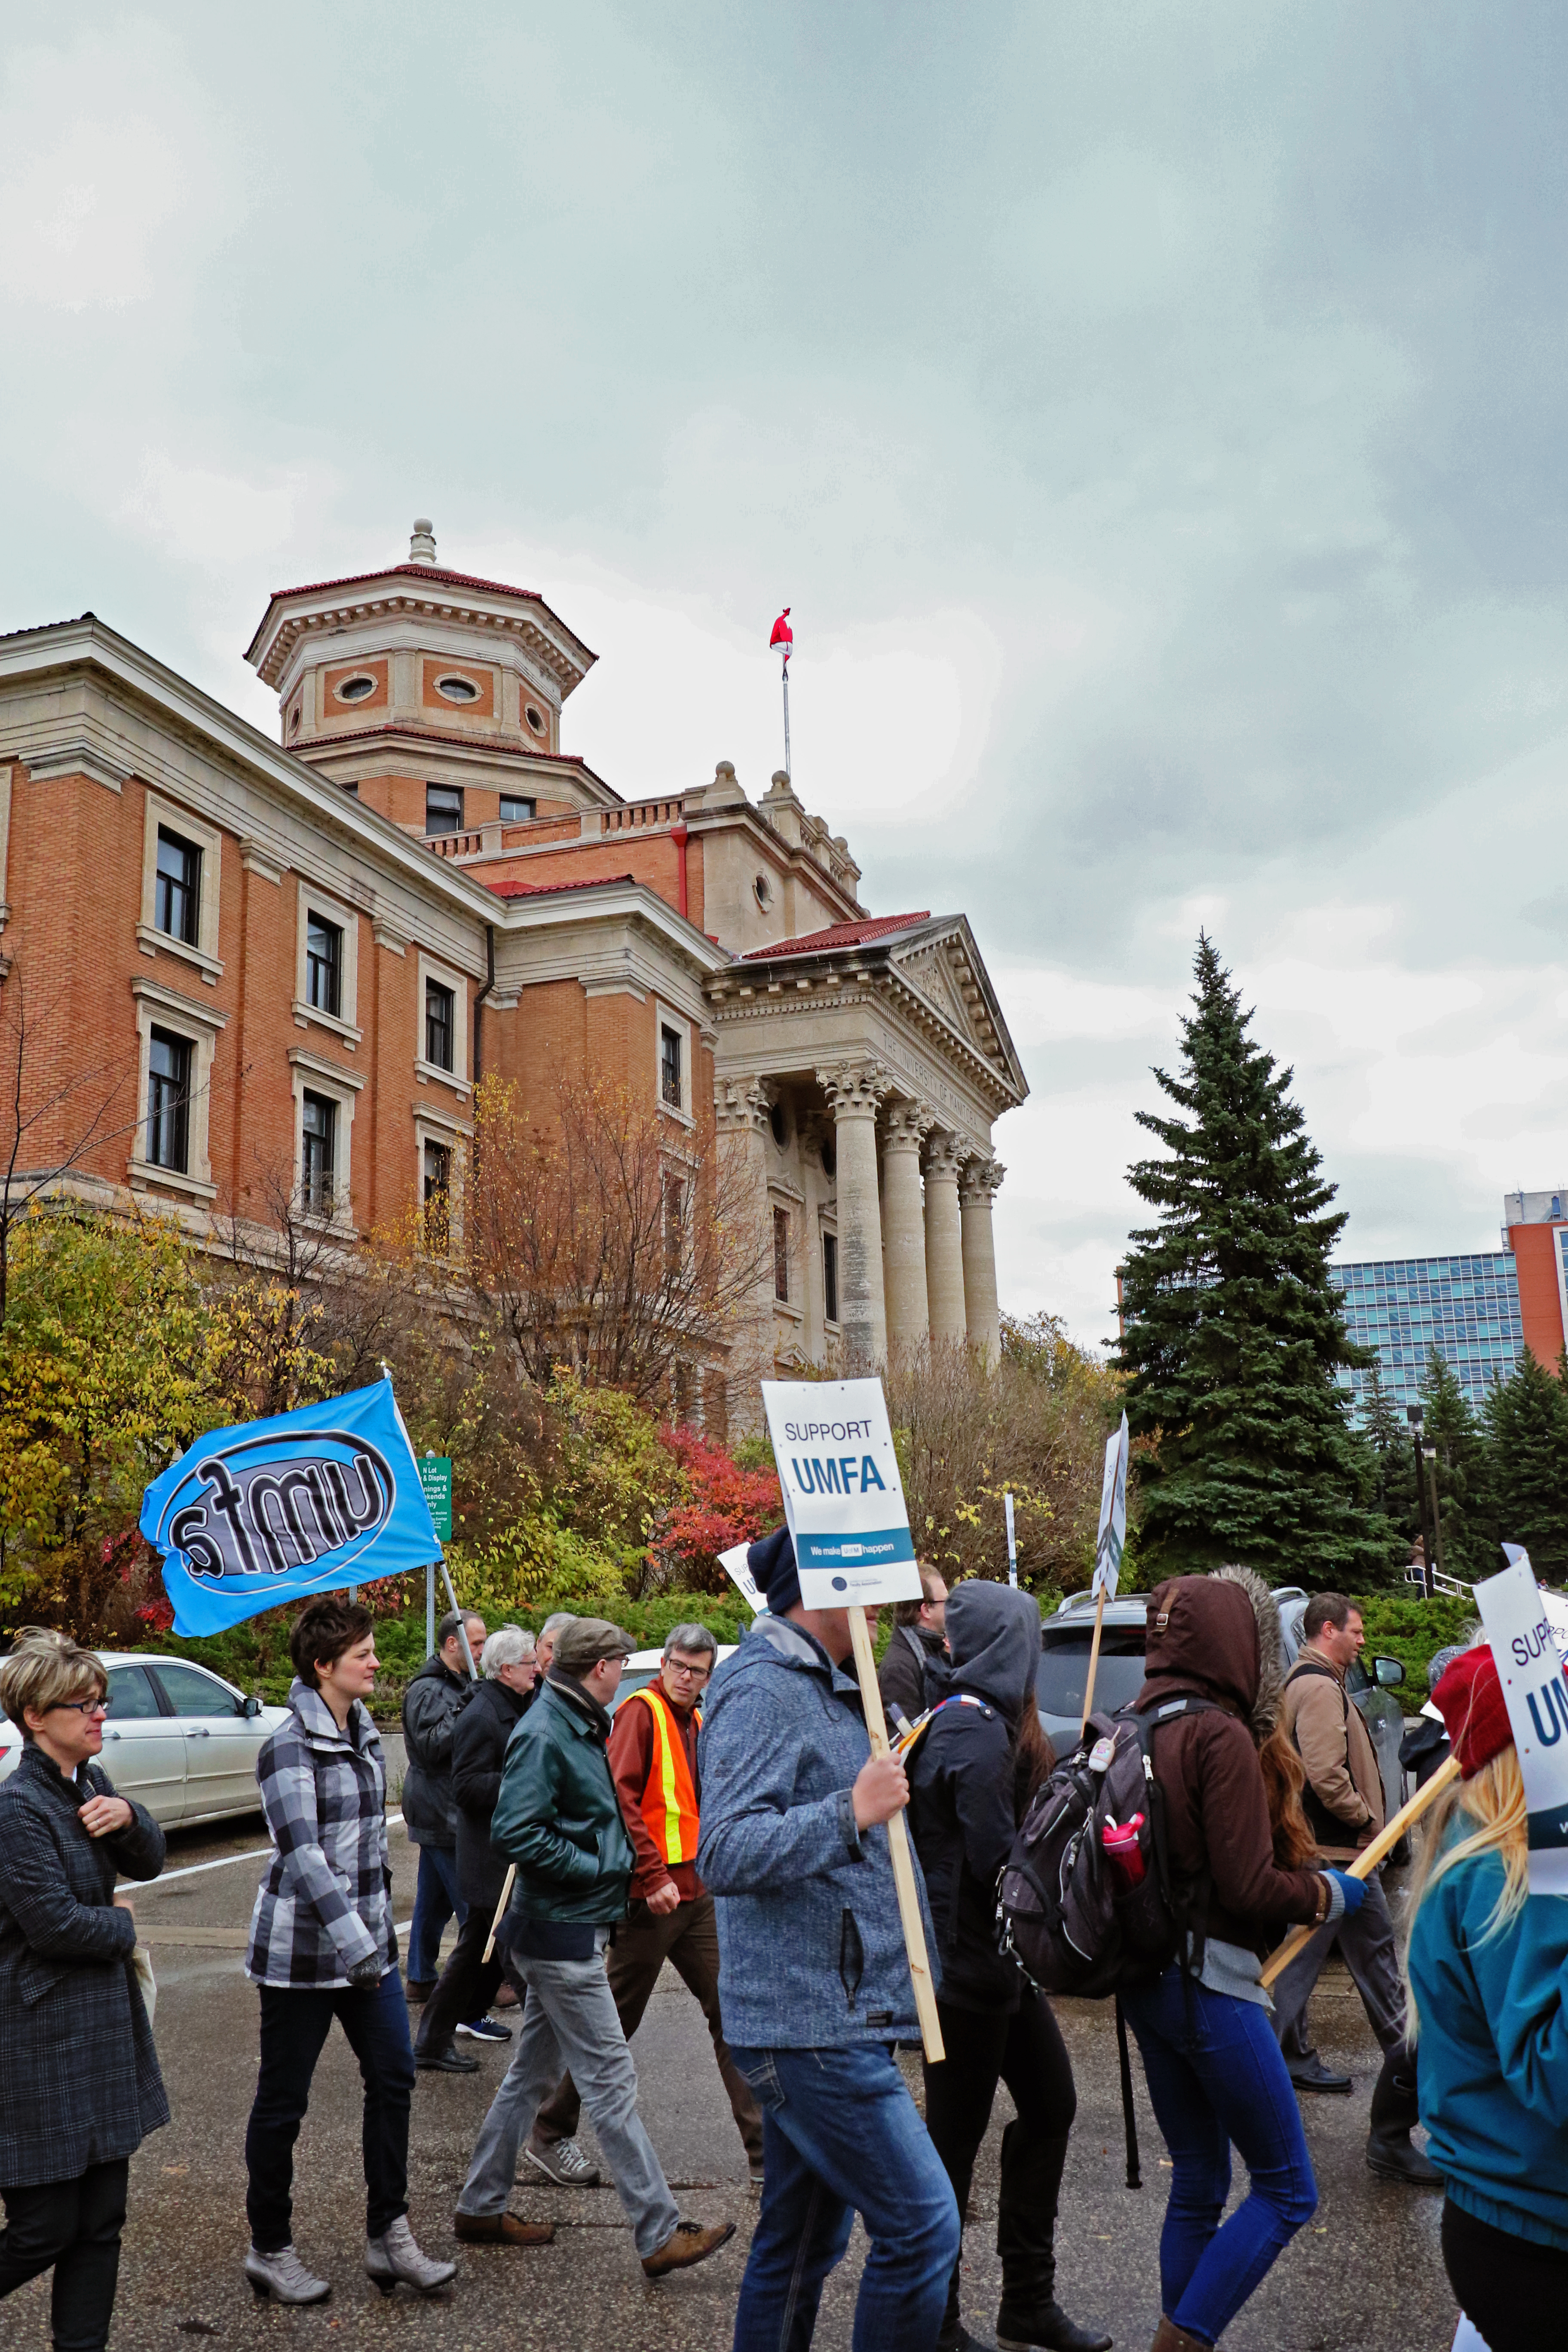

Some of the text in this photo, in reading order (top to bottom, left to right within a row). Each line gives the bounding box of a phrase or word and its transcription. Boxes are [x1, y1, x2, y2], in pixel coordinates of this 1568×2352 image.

[883, 1033, 977, 1130] THE UNIVERSITY OF MANITOBA
[785, 1420, 872, 1441] SUPPORT
[428, 1474, 447, 1482] Display
[791, 1455, 886, 1494] UMFA
[811, 1546, 822, 1556] We
[823, 1546, 841, 1555] make
[862, 1544, 894, 1555] happen
